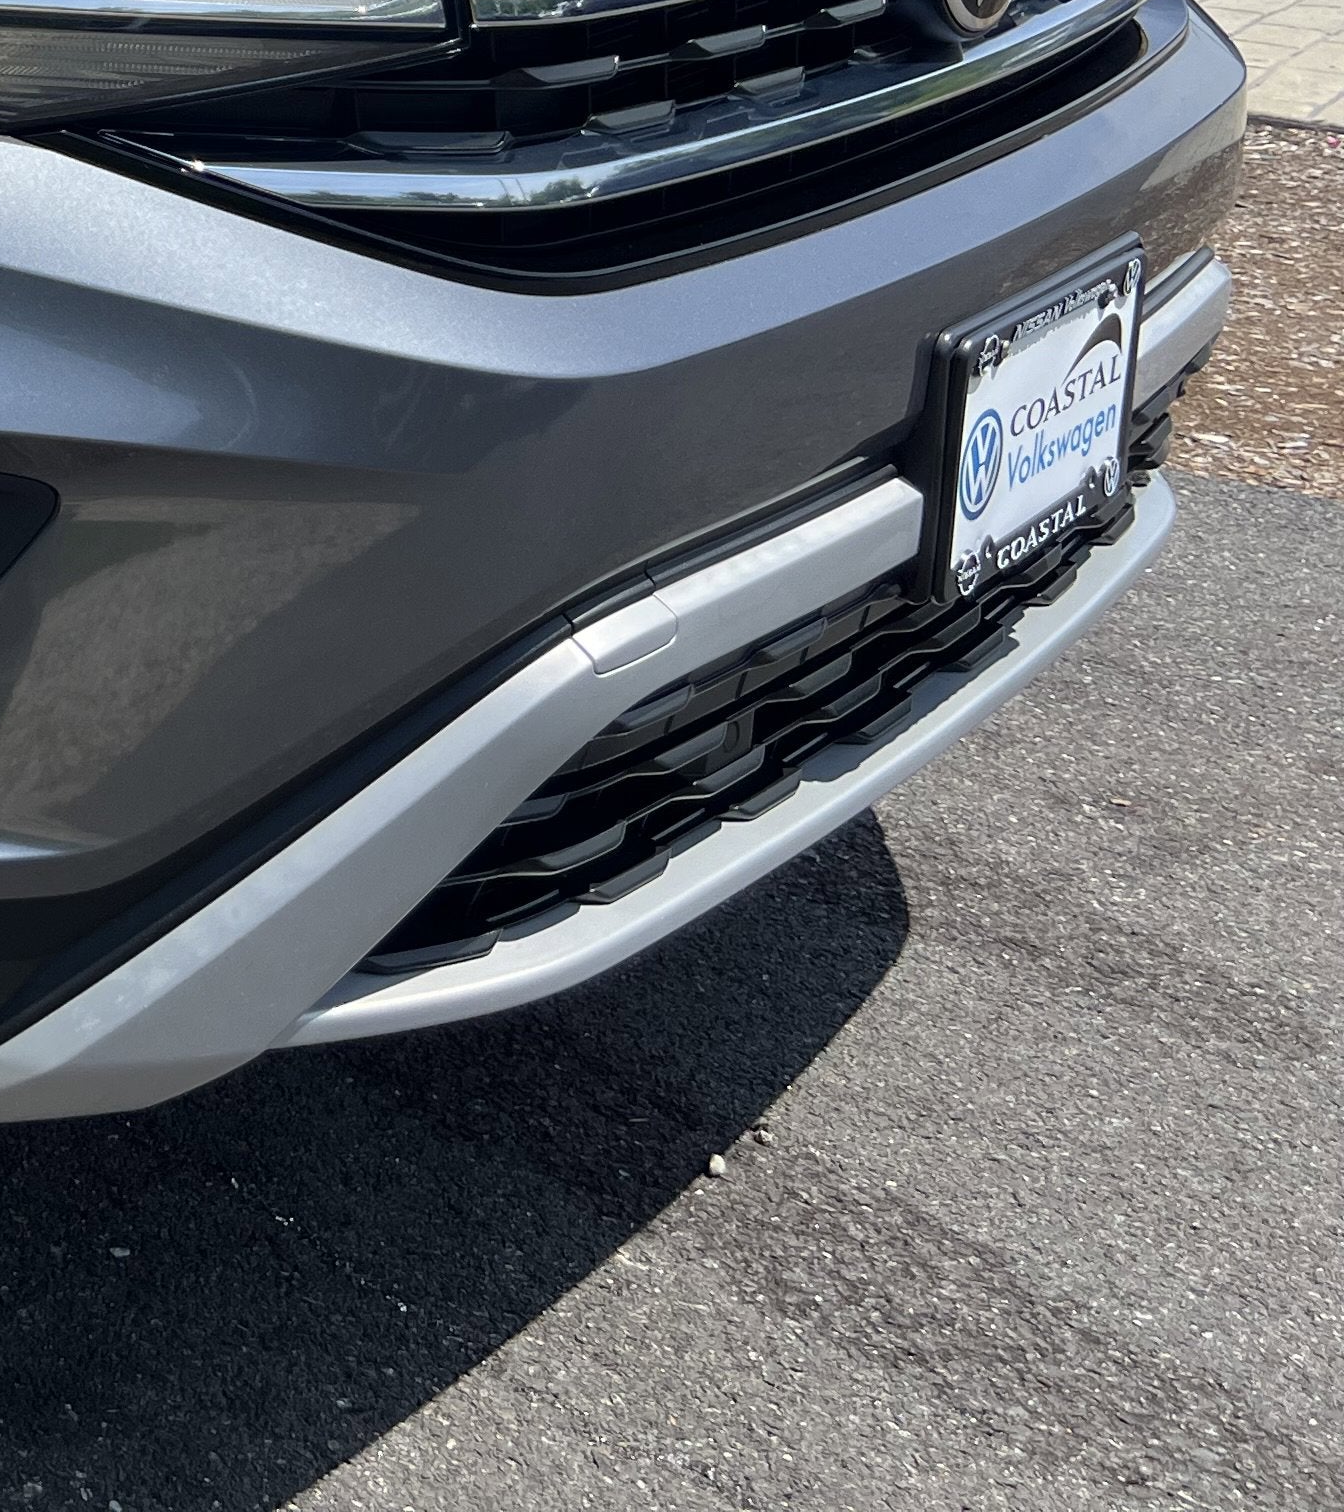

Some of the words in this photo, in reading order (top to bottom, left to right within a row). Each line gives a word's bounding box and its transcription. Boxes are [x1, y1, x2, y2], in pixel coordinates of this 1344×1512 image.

[1013, 302, 1063, 342] NISSAN
[1011, 354, 1122, 437] COASTAL
[960, 408, 1003, 520] VW
[1008, 404, 1117, 492] Volkswagen
[997, 494, 1086, 569] COASTAL
